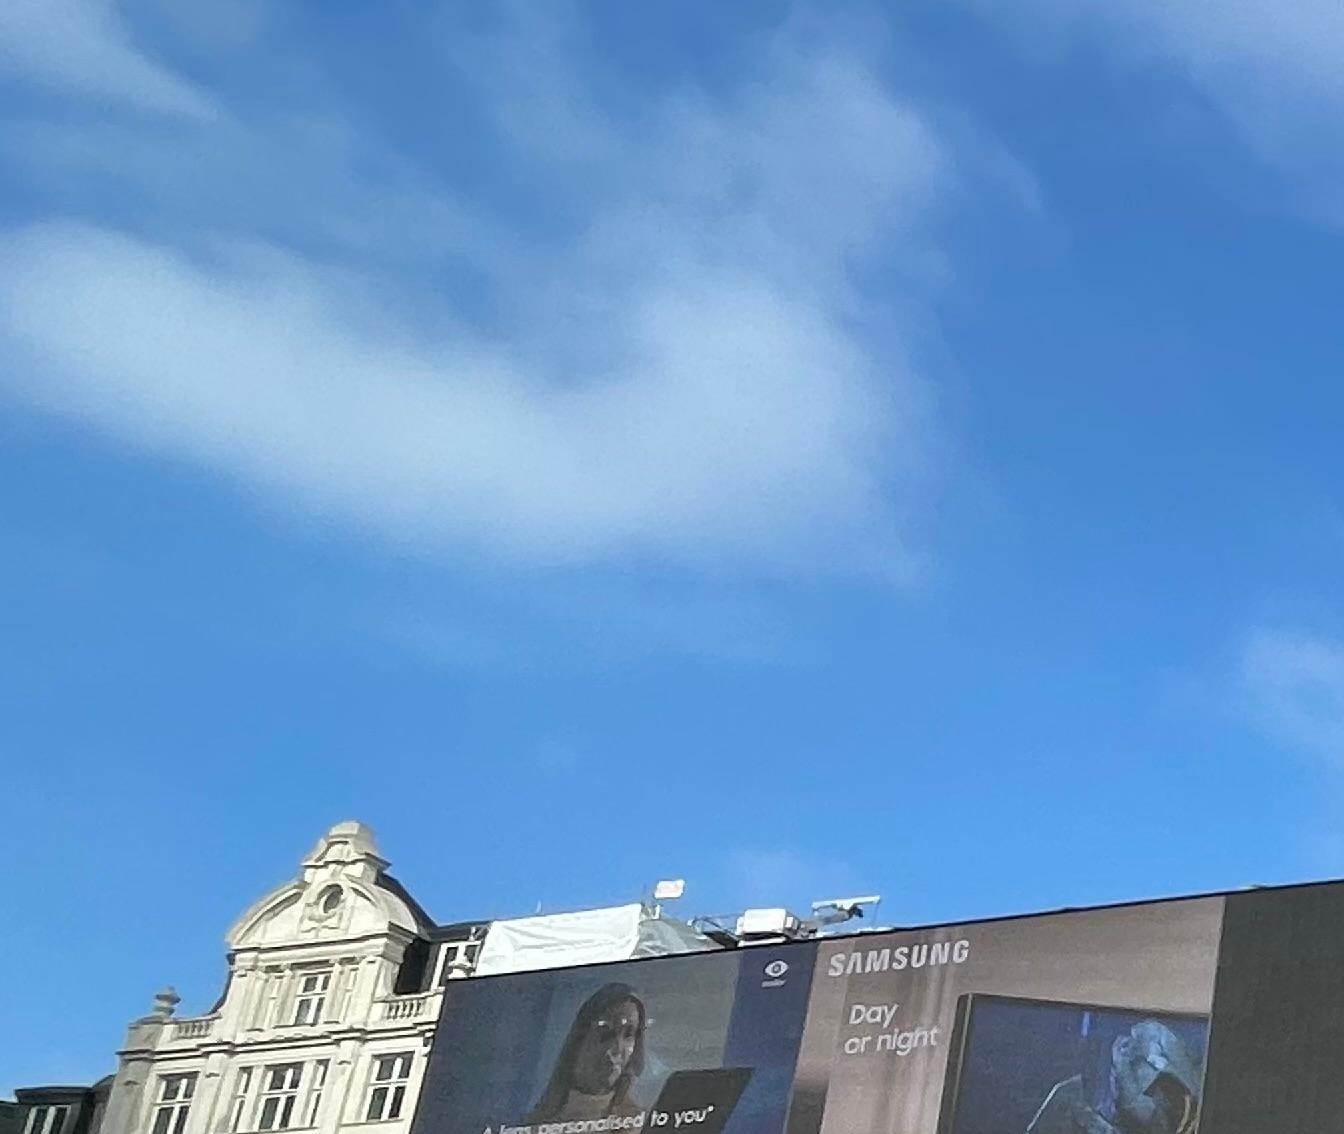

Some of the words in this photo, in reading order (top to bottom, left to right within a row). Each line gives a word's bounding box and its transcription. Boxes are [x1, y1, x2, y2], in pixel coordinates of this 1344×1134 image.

[828, 940, 970, 976] SAMSUNG
[848, 1003, 899, 1028] Day
[844, 1036, 873, 1054] or
[876, 1024, 941, 1056] night
[651, 1111, 668, 1127] to
